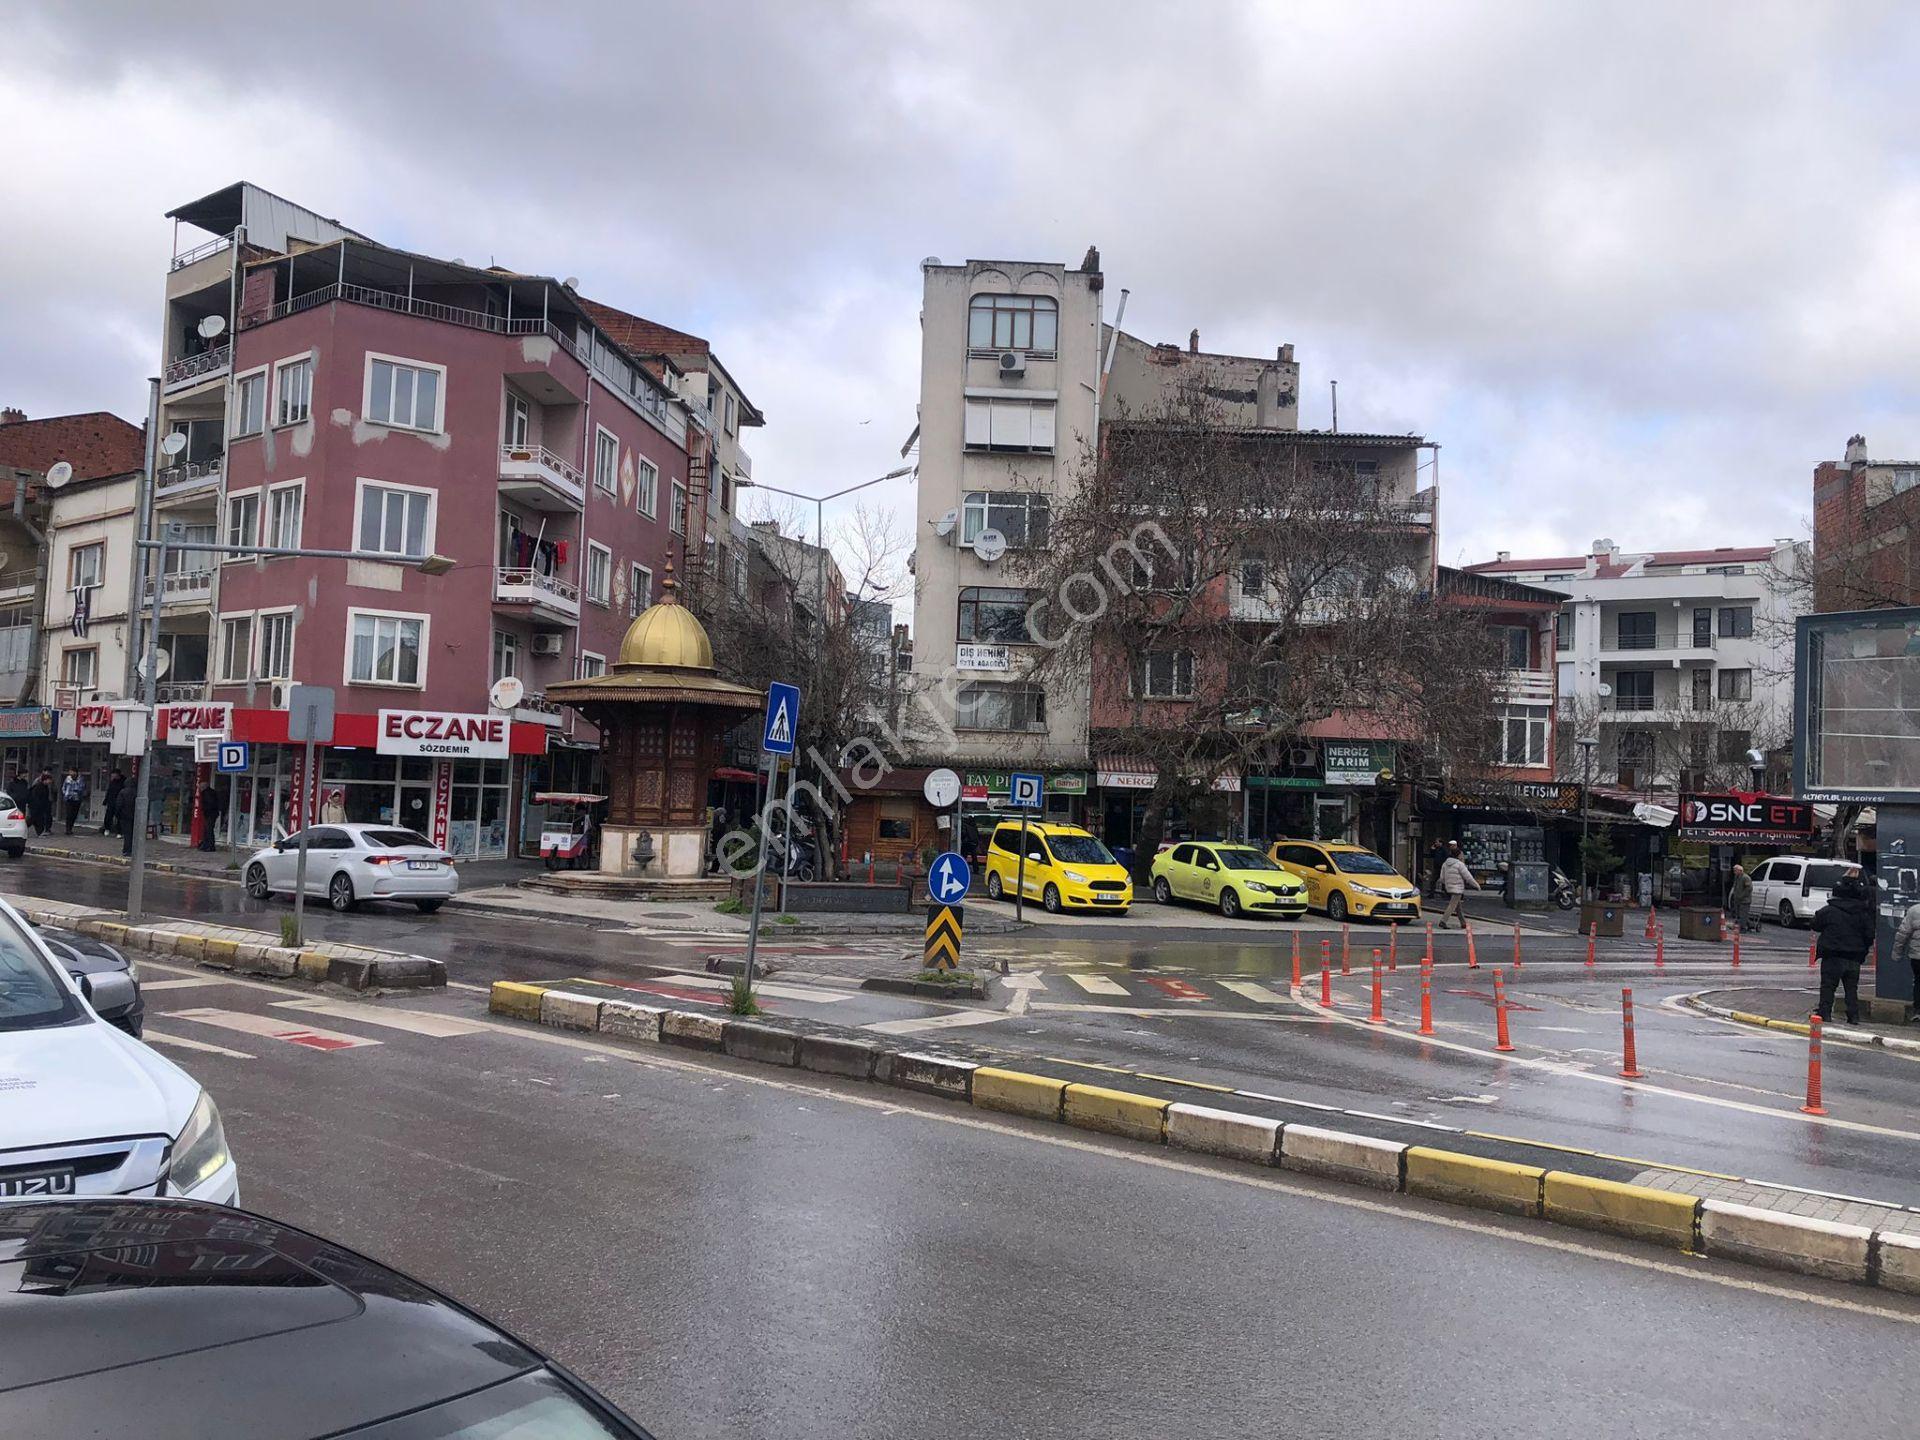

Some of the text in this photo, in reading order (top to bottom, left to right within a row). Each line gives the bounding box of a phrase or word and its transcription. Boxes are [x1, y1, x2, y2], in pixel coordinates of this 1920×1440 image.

[80, 706, 113, 727] ECZA
[169, 707, 225, 729] ECZANE
[385, 714, 504, 742] ECZANE
[227, 749, 240, 764] D
[419, 744, 470, 754] SÖZDEMİR
[1329, 757, 1369, 767] TARIM
[1020, 781, 1033, 798] D
[1056, 779, 1080, 787] Banvit
[290, 757, 301, 832] ECZAN
[435, 763, 449, 851] ECZANE
[1710, 804, 1803, 824] SNC ET
